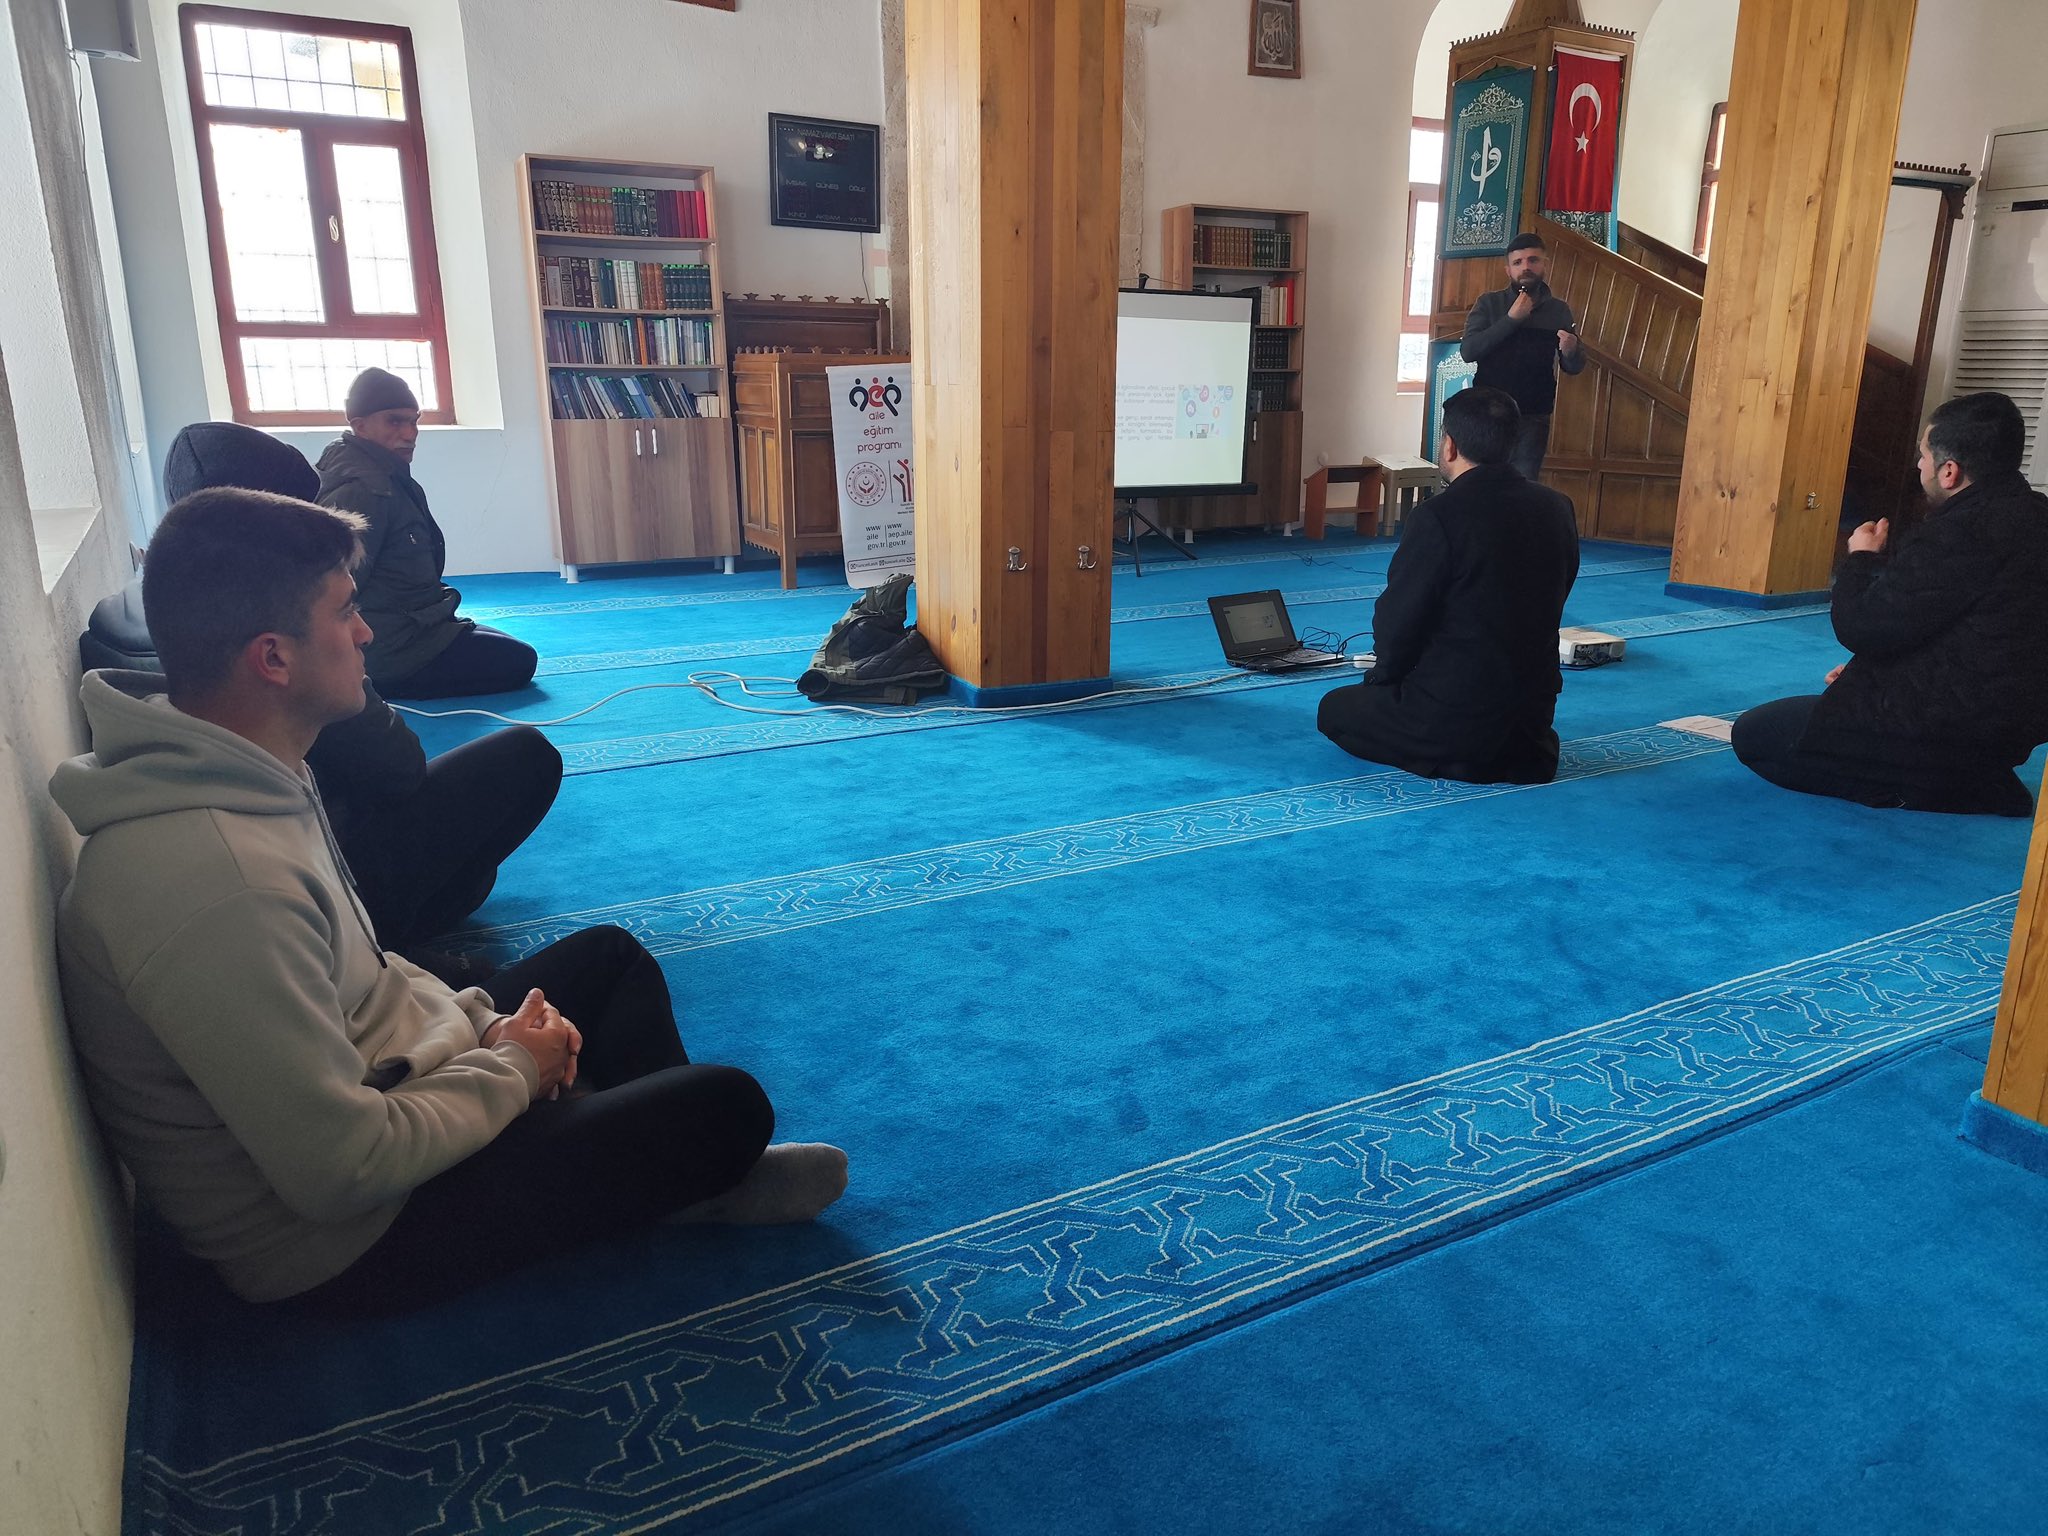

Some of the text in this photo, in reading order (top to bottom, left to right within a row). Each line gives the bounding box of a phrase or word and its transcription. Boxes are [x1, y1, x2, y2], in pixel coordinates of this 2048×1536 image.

[868, 411, 885, 420] aile
[863, 425, 894, 439] eğitim
[866, 533, 879, 541] aile
